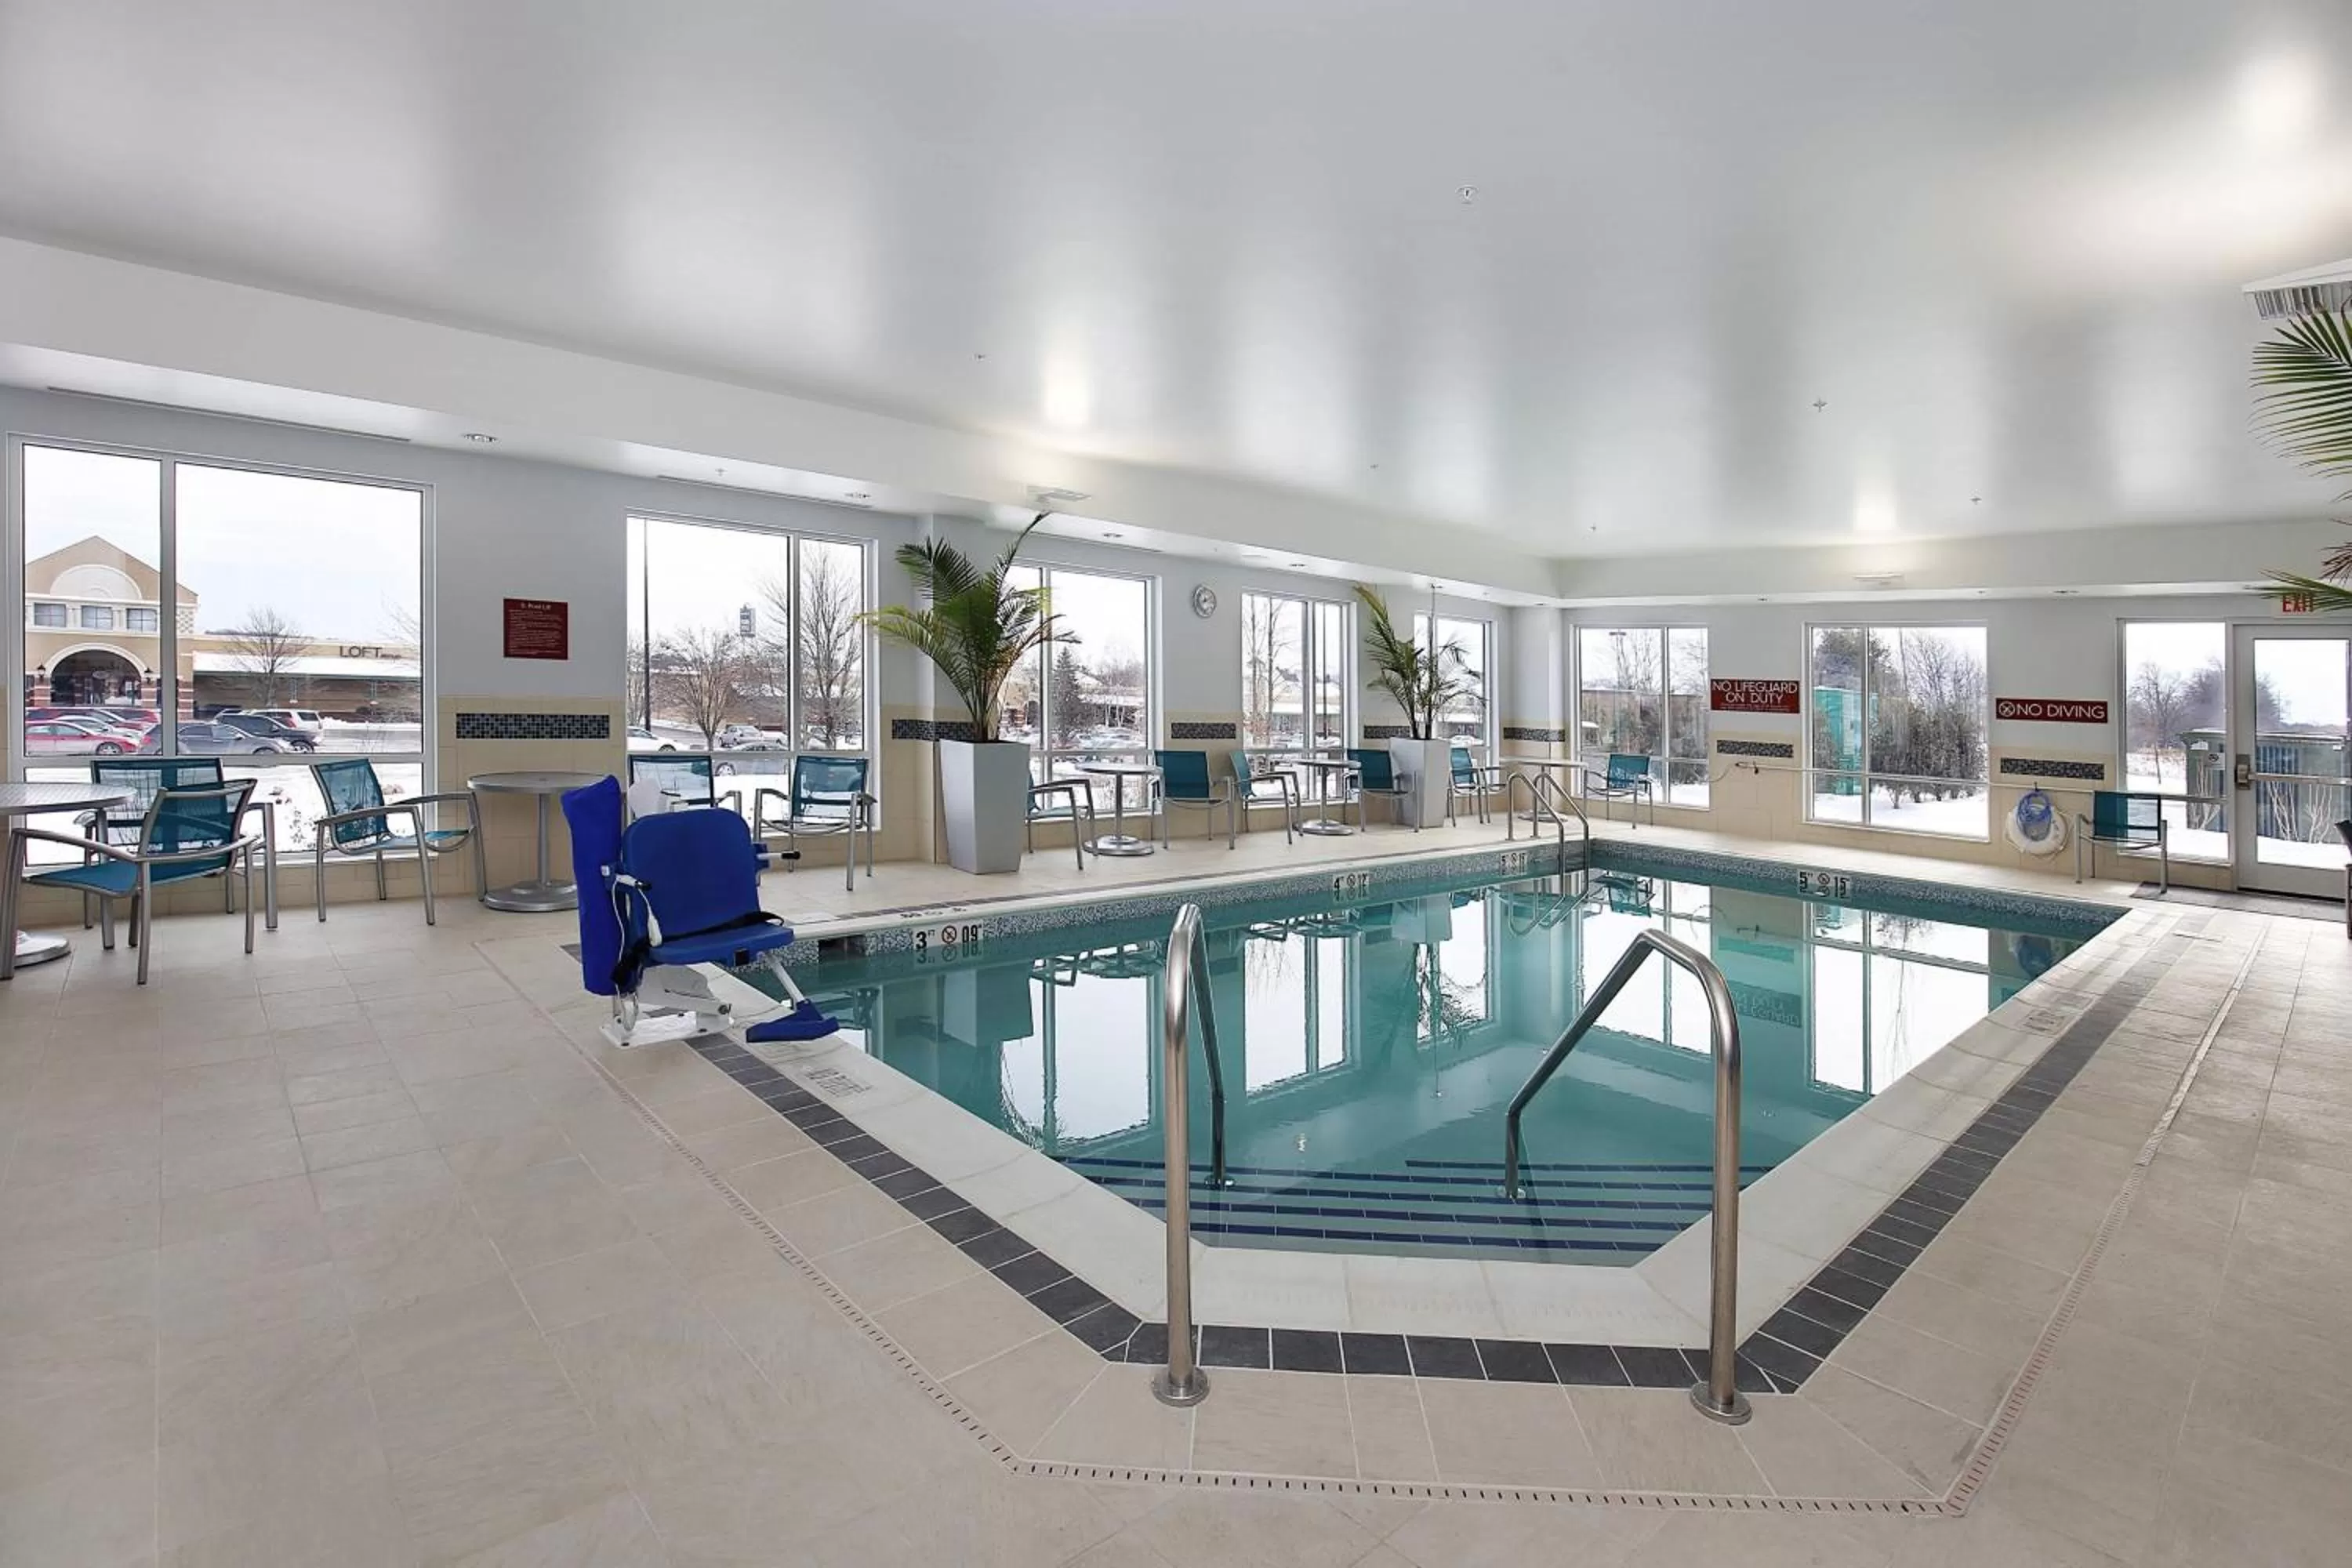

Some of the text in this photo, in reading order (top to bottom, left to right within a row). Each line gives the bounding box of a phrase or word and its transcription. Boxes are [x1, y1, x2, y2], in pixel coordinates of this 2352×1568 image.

[339, 645, 383, 658] LOFT
[1712, 680, 1798, 694] NO LIFEGUARD
[1726, 691, 1784, 704] ON DUTY
[2016, 703, 2105, 720] NO DIVING
